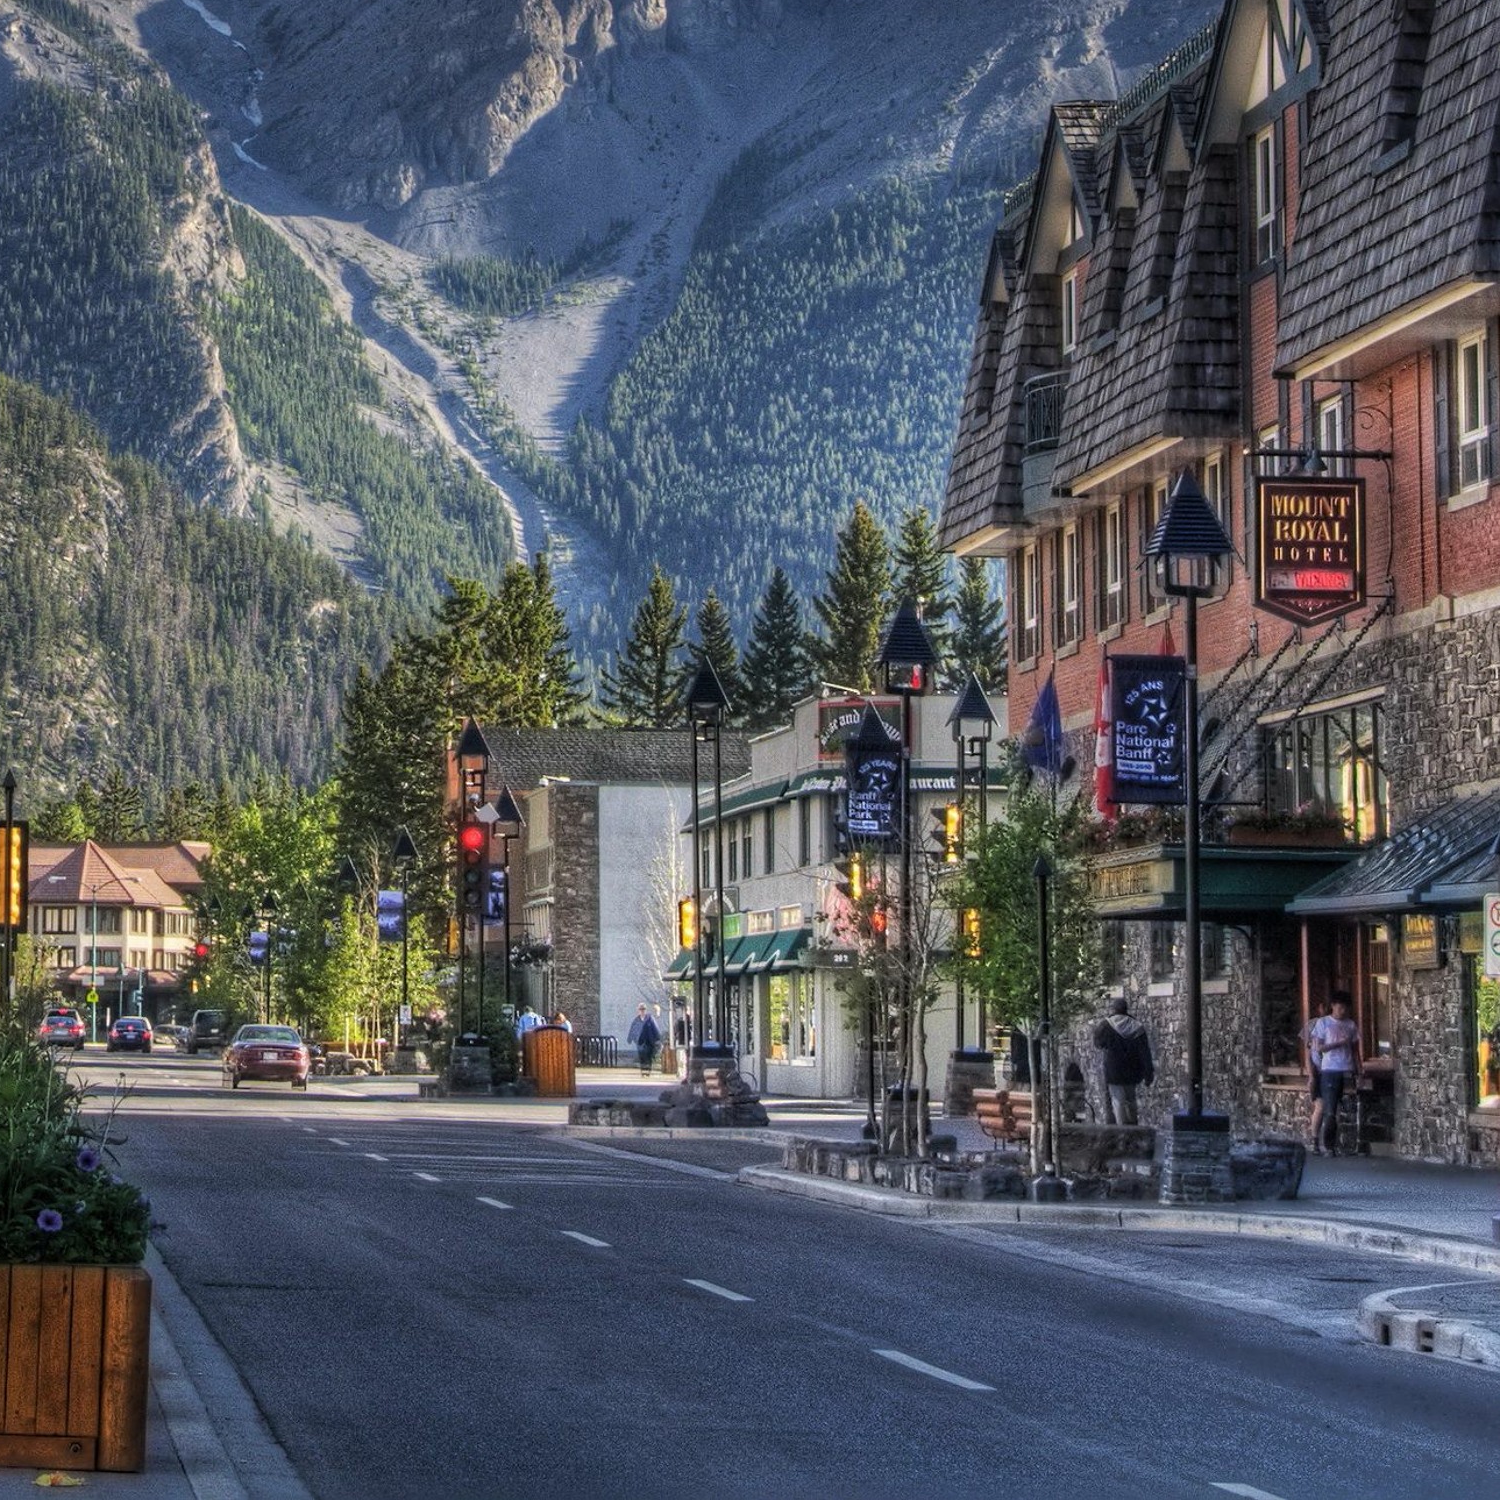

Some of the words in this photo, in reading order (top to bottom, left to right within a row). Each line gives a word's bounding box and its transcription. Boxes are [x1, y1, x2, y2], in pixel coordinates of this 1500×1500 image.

[1271, 495, 1349, 517] MOUNT
[1274, 520, 1348, 542] ROYAL
[1274, 547, 1348, 562] HOTEL
[1125, 690, 1140, 705] 125
[1141, 680, 1164, 691] ANS
[839, 708, 860, 726] and
[1116, 721, 1148, 734] Parc
[1116, 734, 1174, 748] National
[1116, 745, 1153, 759] Banff
[871, 759, 898, 772] YEARS
[910, 775, 956, 789] aurant
[848, 790, 877, 801] Banff
[848, 800, 891, 811] National
[848, 809, 873, 819] Park
